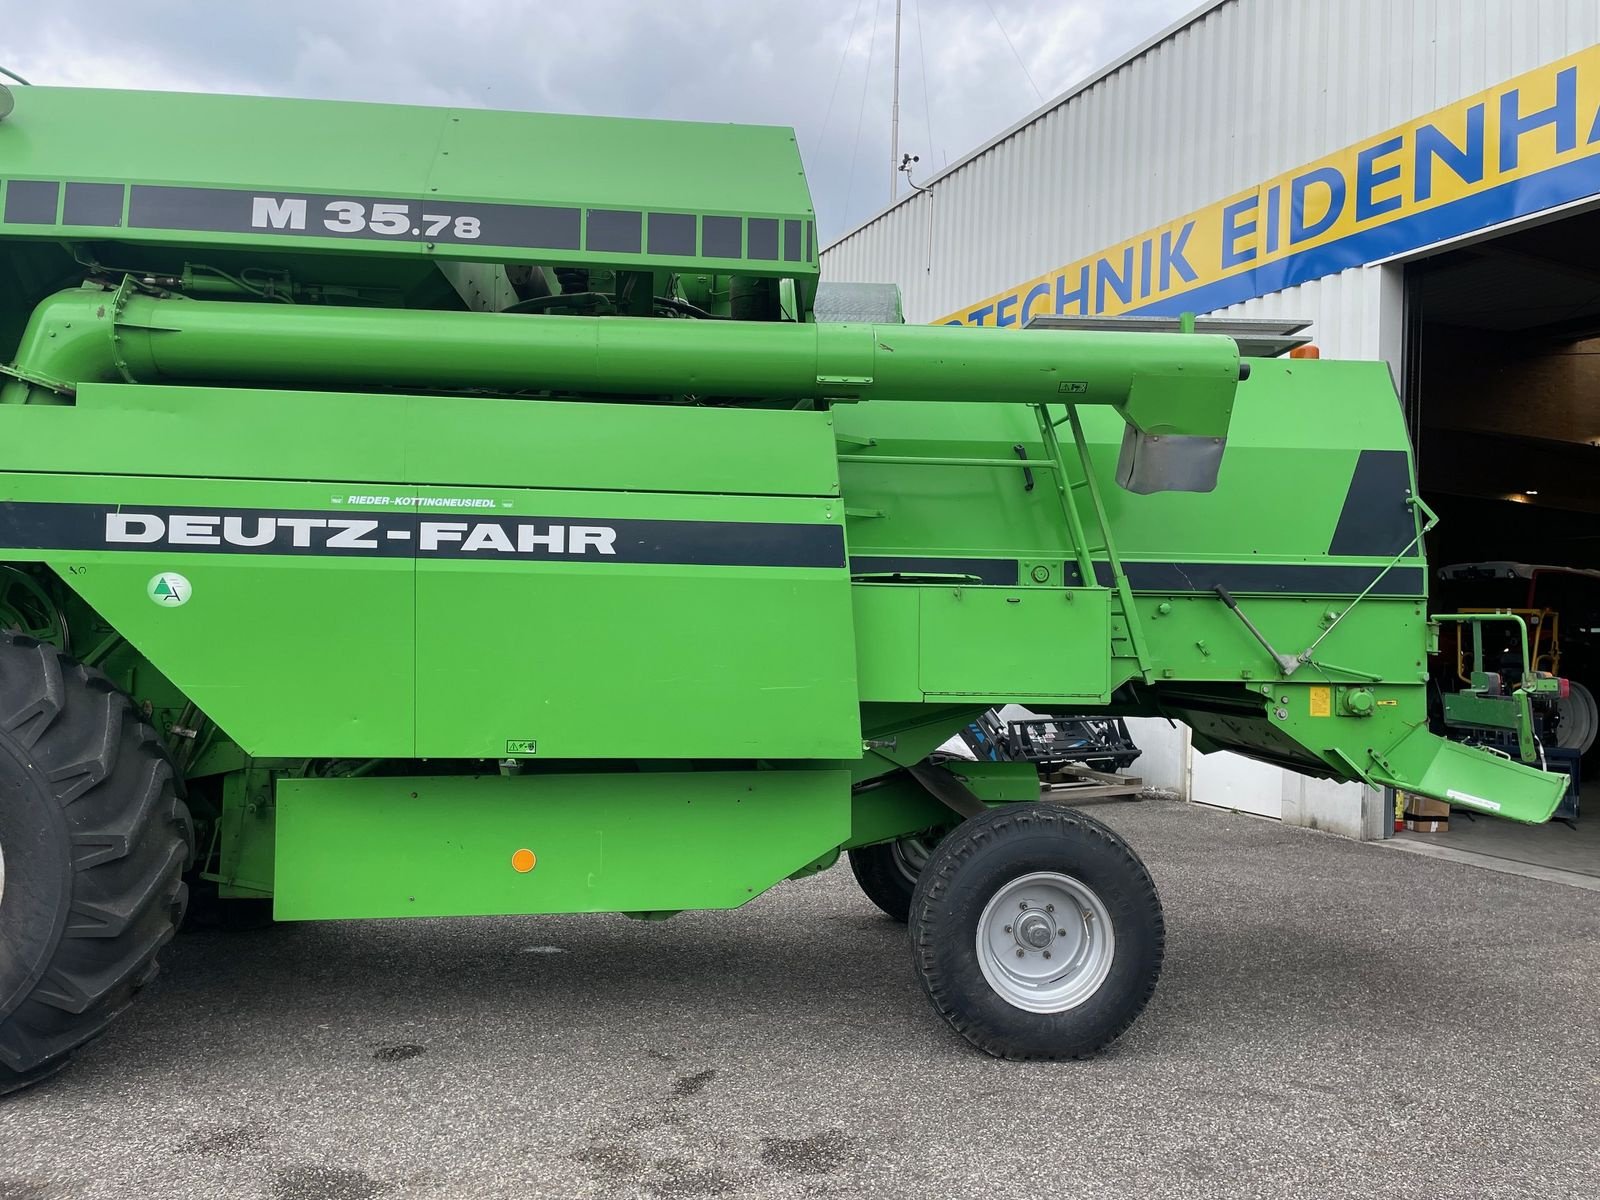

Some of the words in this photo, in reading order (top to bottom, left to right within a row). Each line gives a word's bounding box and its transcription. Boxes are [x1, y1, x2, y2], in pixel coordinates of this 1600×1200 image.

[251, 196, 307, 230] M
[323, 200, 481, 239] 35.78
[943, 221, 1198, 329] TECHNIK
[1220, 65, 1600, 270] EIDENH
[105, 512, 617, 555] DEUTZ-FAHR
